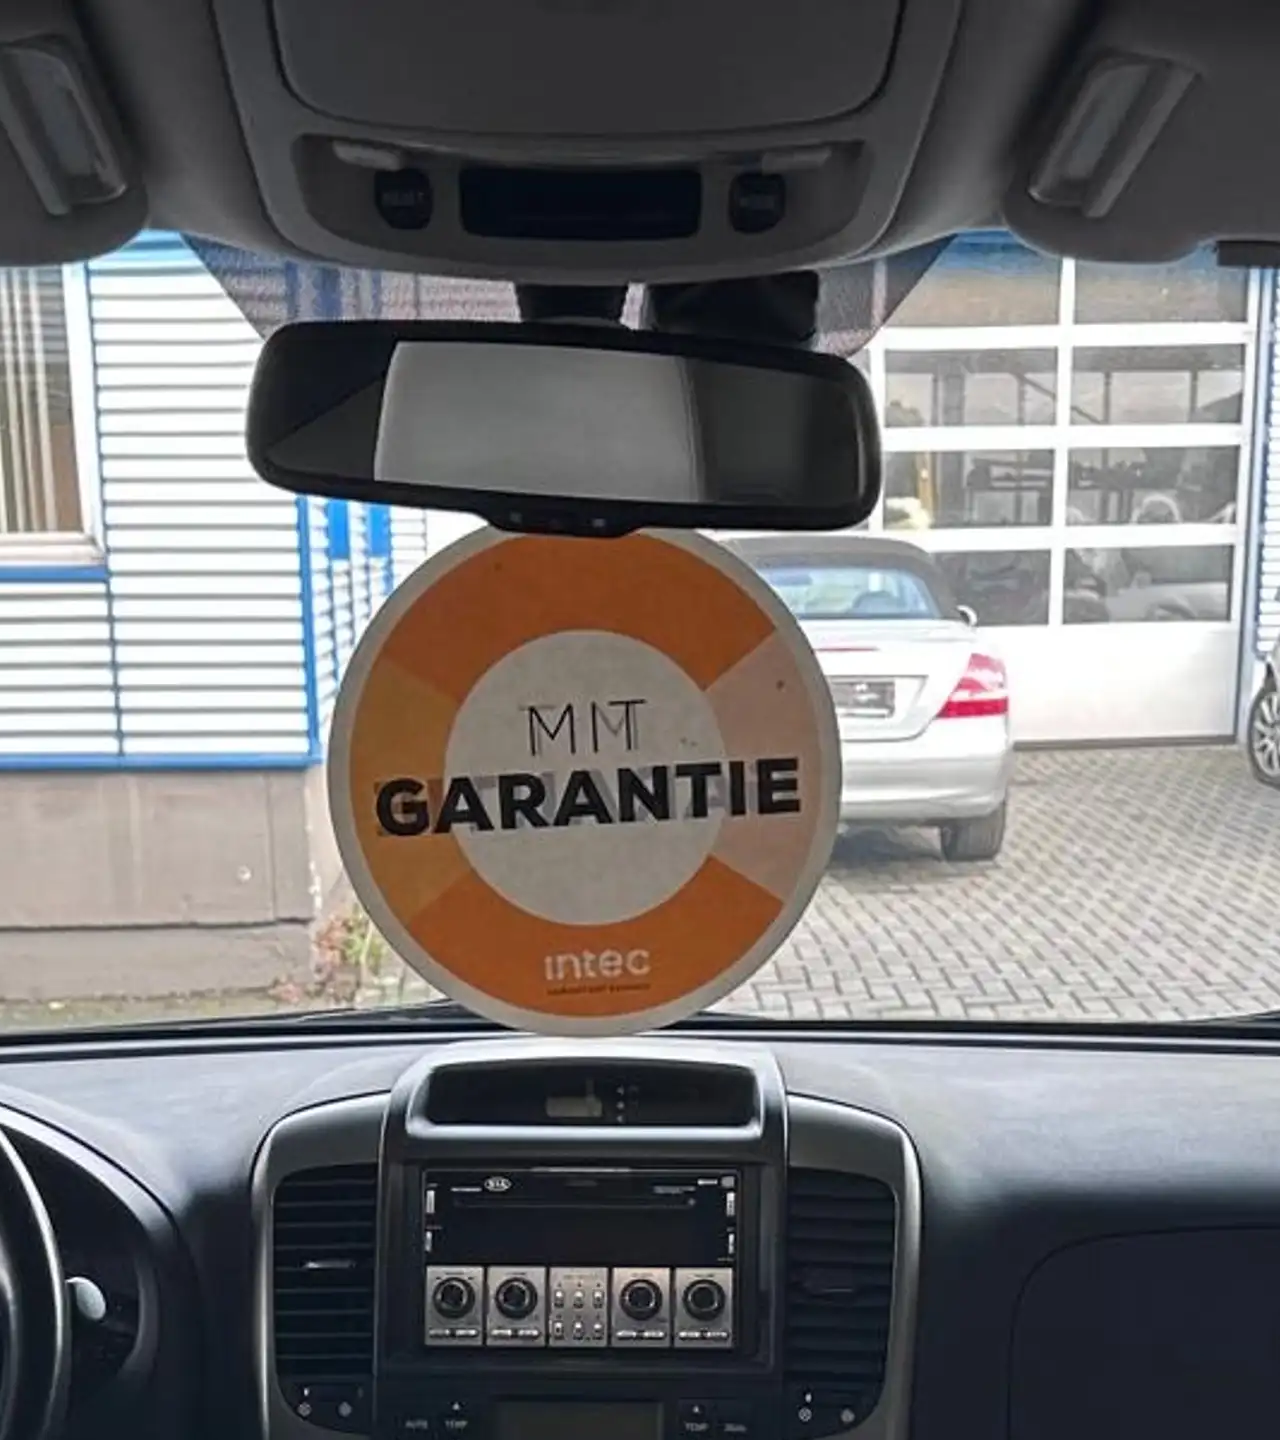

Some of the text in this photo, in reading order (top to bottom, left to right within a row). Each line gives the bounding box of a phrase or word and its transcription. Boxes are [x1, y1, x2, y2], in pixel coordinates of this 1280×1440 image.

[527, 698, 646, 756] MIT
[376, 756, 801, 838] GARANTIE
[543, 947, 650, 981] intec
[444, 1418, 468, 1429] TEMP
[684, 1421, 709, 1432] TEMP
